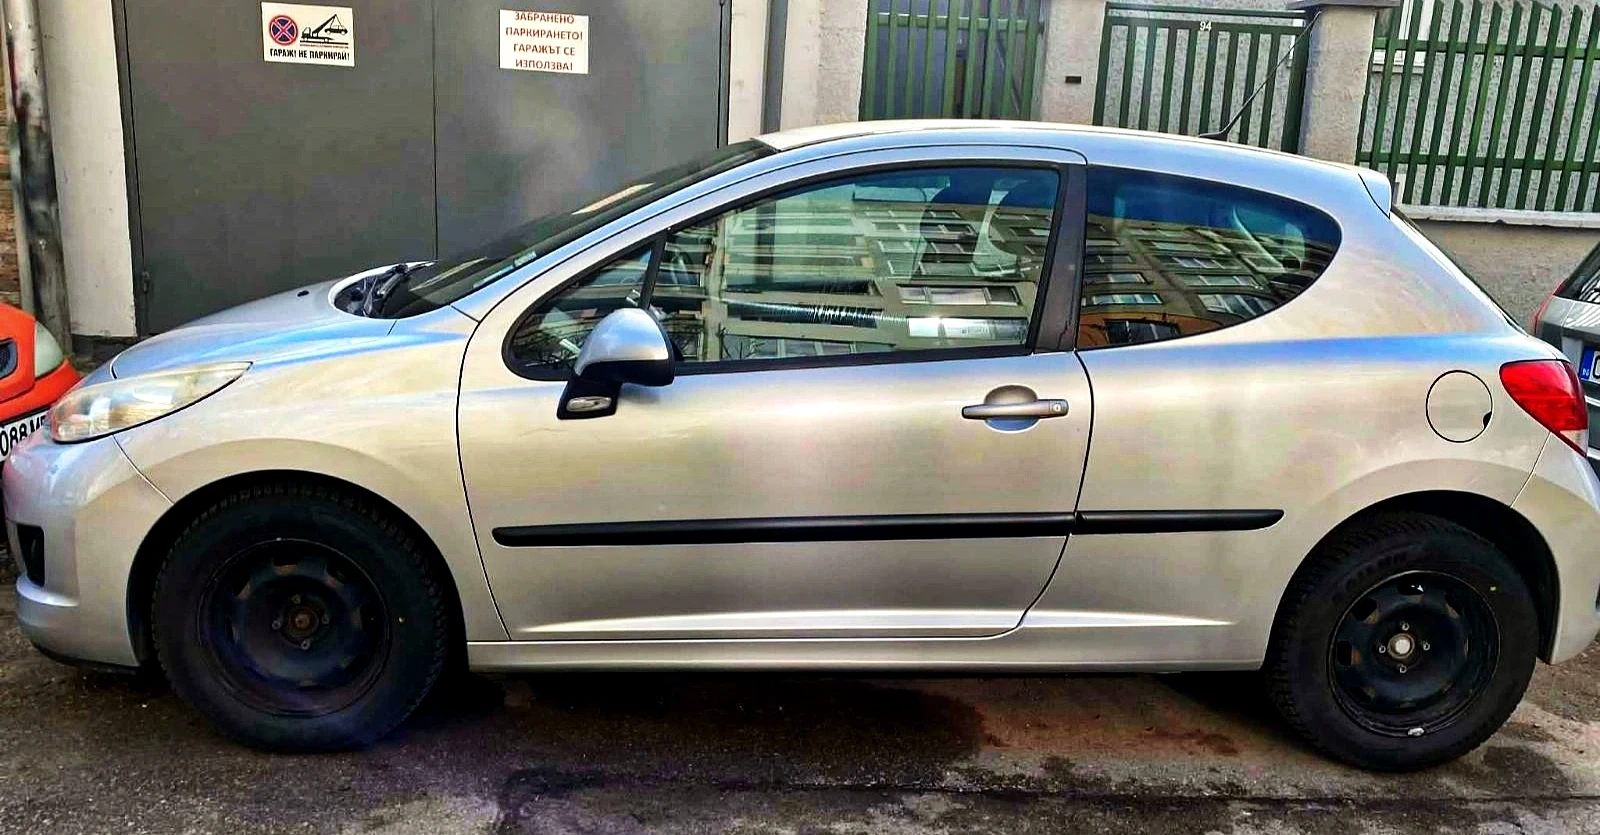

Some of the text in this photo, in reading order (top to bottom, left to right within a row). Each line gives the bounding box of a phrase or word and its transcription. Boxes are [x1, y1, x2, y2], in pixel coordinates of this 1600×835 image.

[514, 12, 575, 24] ЗАБРАНЕНО
[1200, 20, 1211, 31] 94
[505, 27, 583, 40] ПАРКИРАНЕТО!
[270, 48, 350, 60] ГАРАЖ! НЕ ПАРКИРАЙ!
[513, 43, 576, 56] ГАРАЖЪТ СЕ
[515, 59, 573, 71] ИЗПОЛЗВА!
